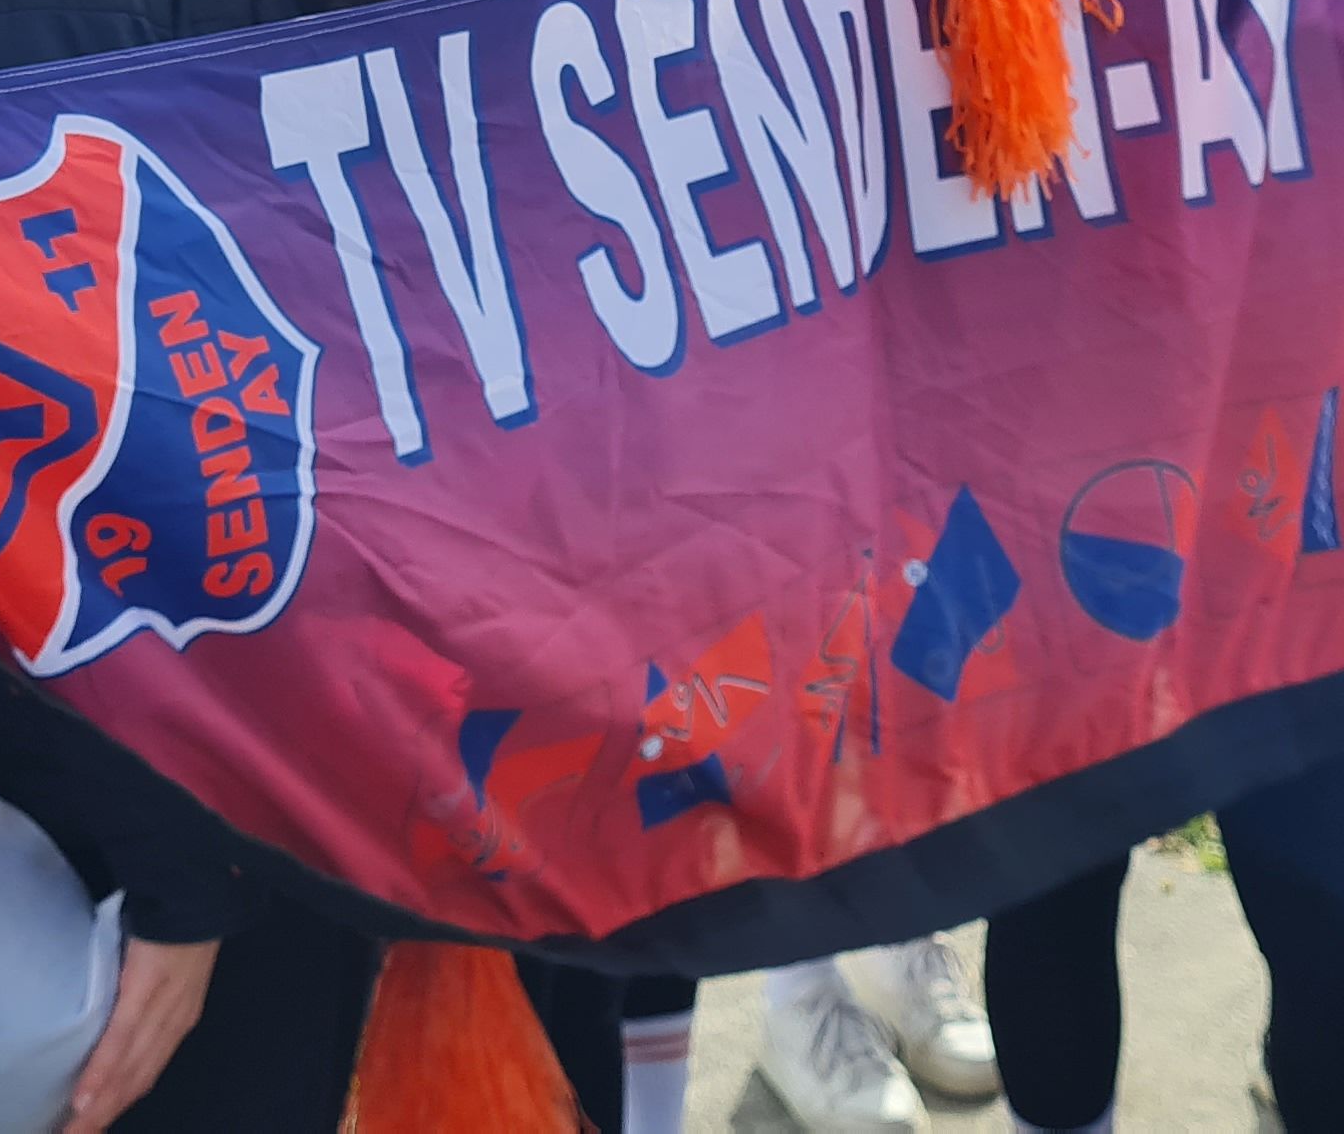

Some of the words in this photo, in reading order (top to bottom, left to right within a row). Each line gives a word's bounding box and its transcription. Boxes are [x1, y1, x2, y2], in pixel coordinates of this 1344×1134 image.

[20, 209, 98, 313] 11
[260, 31, 531, 460] TV
[218, 333, 291, 423] AY
[150, 290, 276, 600] SENDEN
[84, 512, 152, 598] 19
